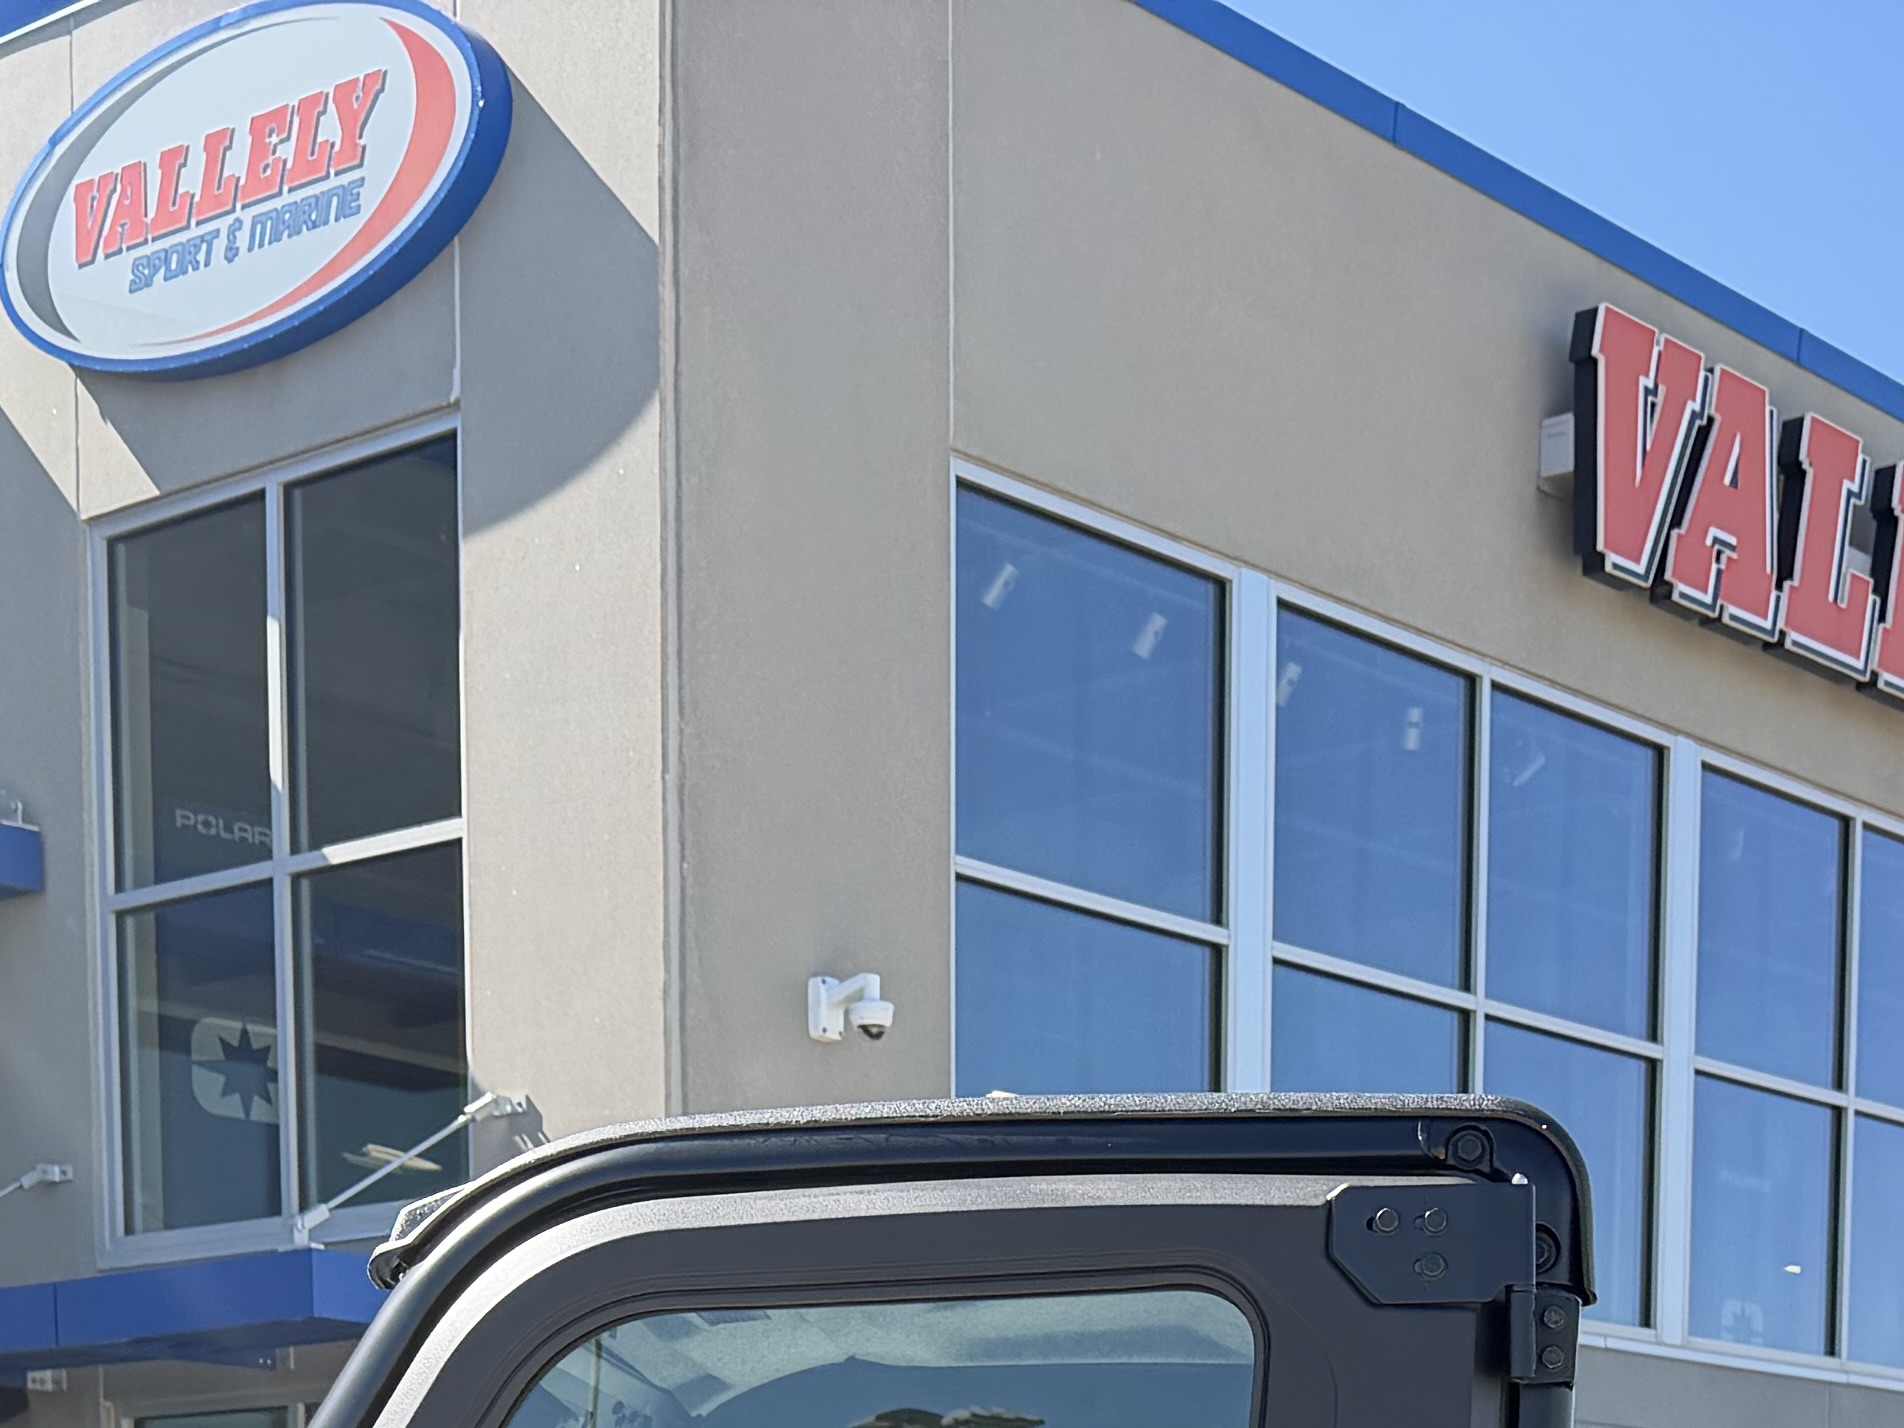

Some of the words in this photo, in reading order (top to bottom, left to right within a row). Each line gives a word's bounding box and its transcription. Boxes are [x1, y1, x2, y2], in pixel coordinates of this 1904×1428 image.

[72, 69, 388, 268] VALLELY
[127, 228, 220, 294] SPORT
[223, 219, 244, 264] &
[247, 176, 366, 252] MARINE
[175, 808, 273, 849] POLAR
